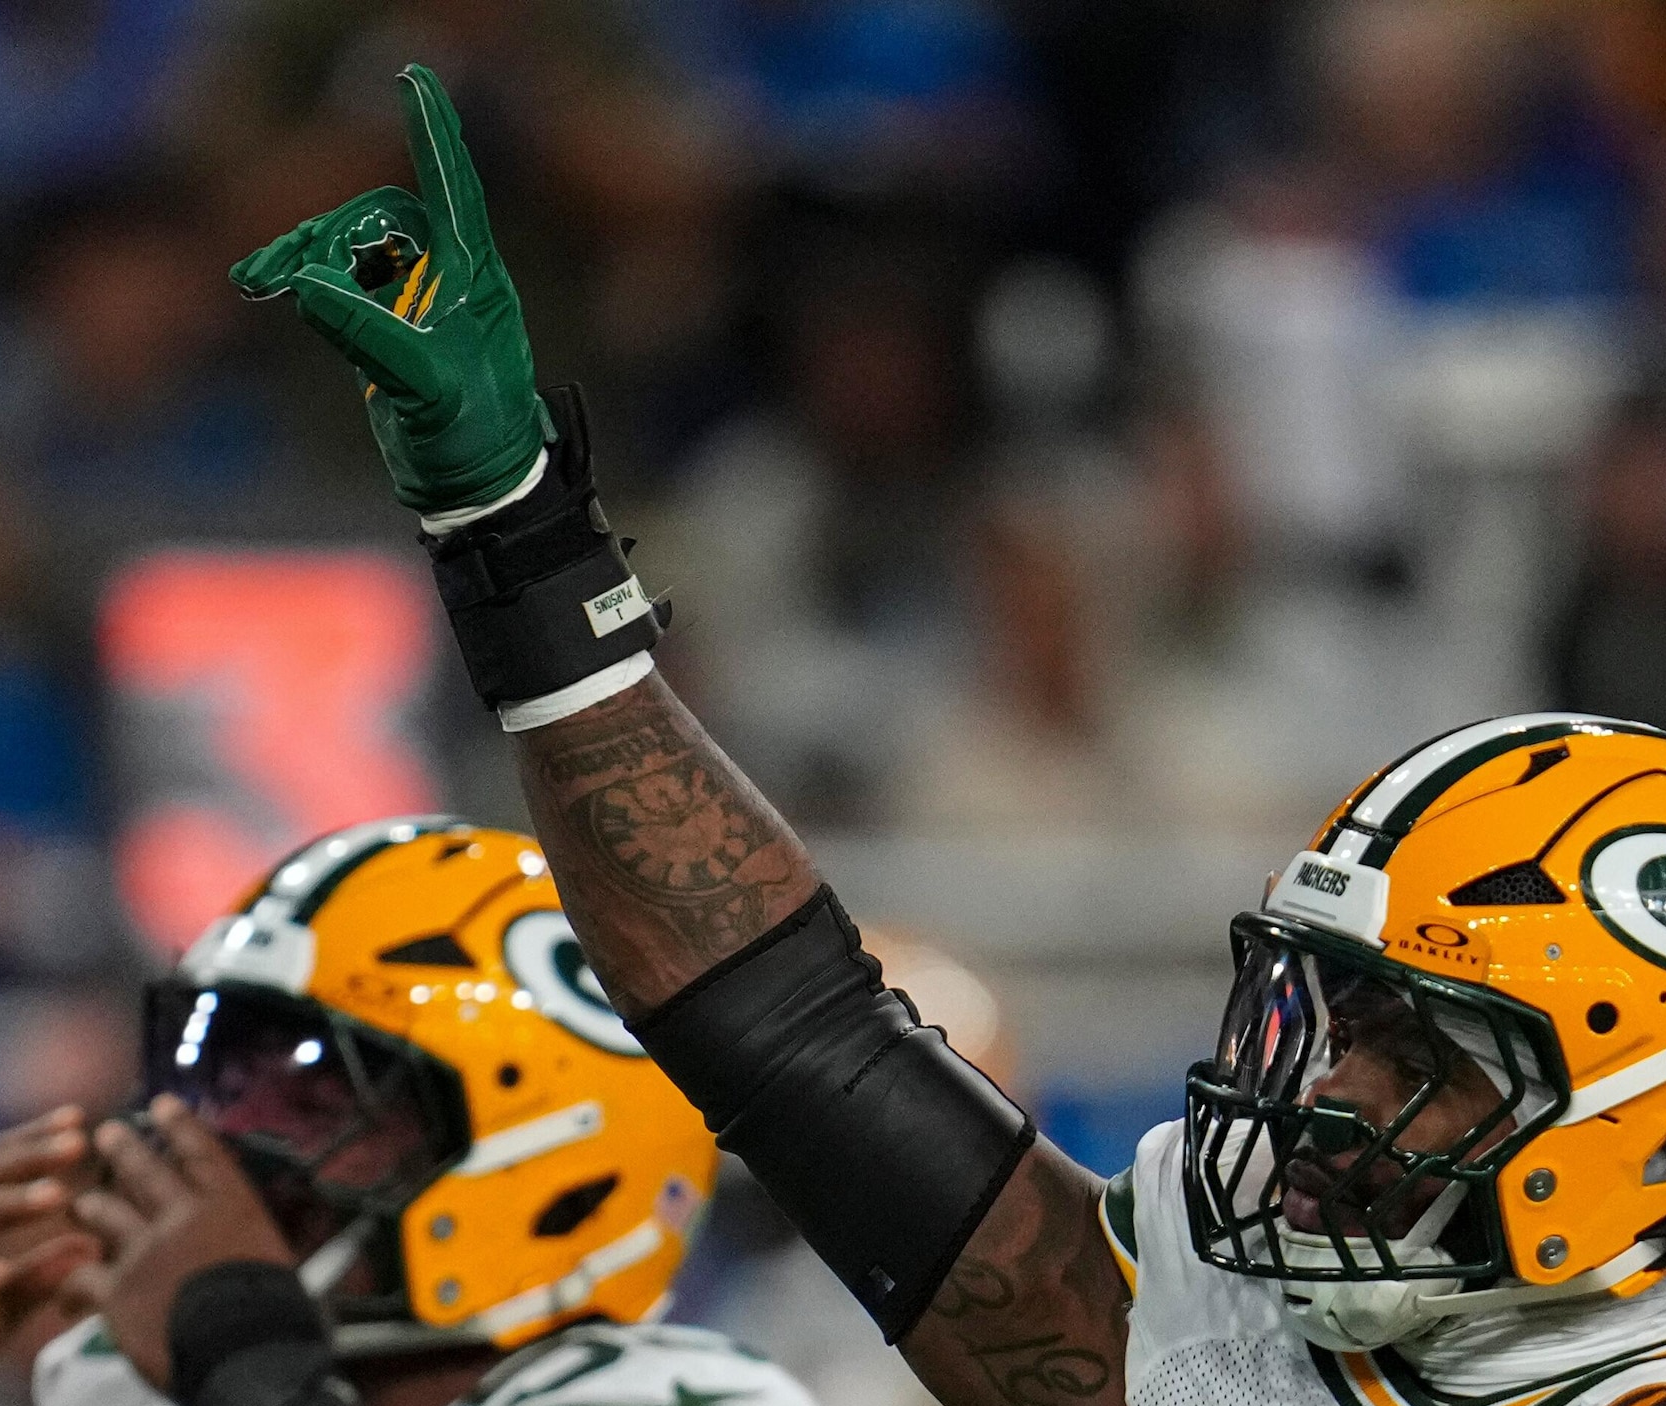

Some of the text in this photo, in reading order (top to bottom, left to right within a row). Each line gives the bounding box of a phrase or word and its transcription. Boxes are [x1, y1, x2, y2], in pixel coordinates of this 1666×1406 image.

[594, 585, 633, 614] PARSONS
[615, 607, 624, 621] 1
[1293, 862, 1351, 897] PACKERS
[1398, 939, 1480, 965] OAKLEY
